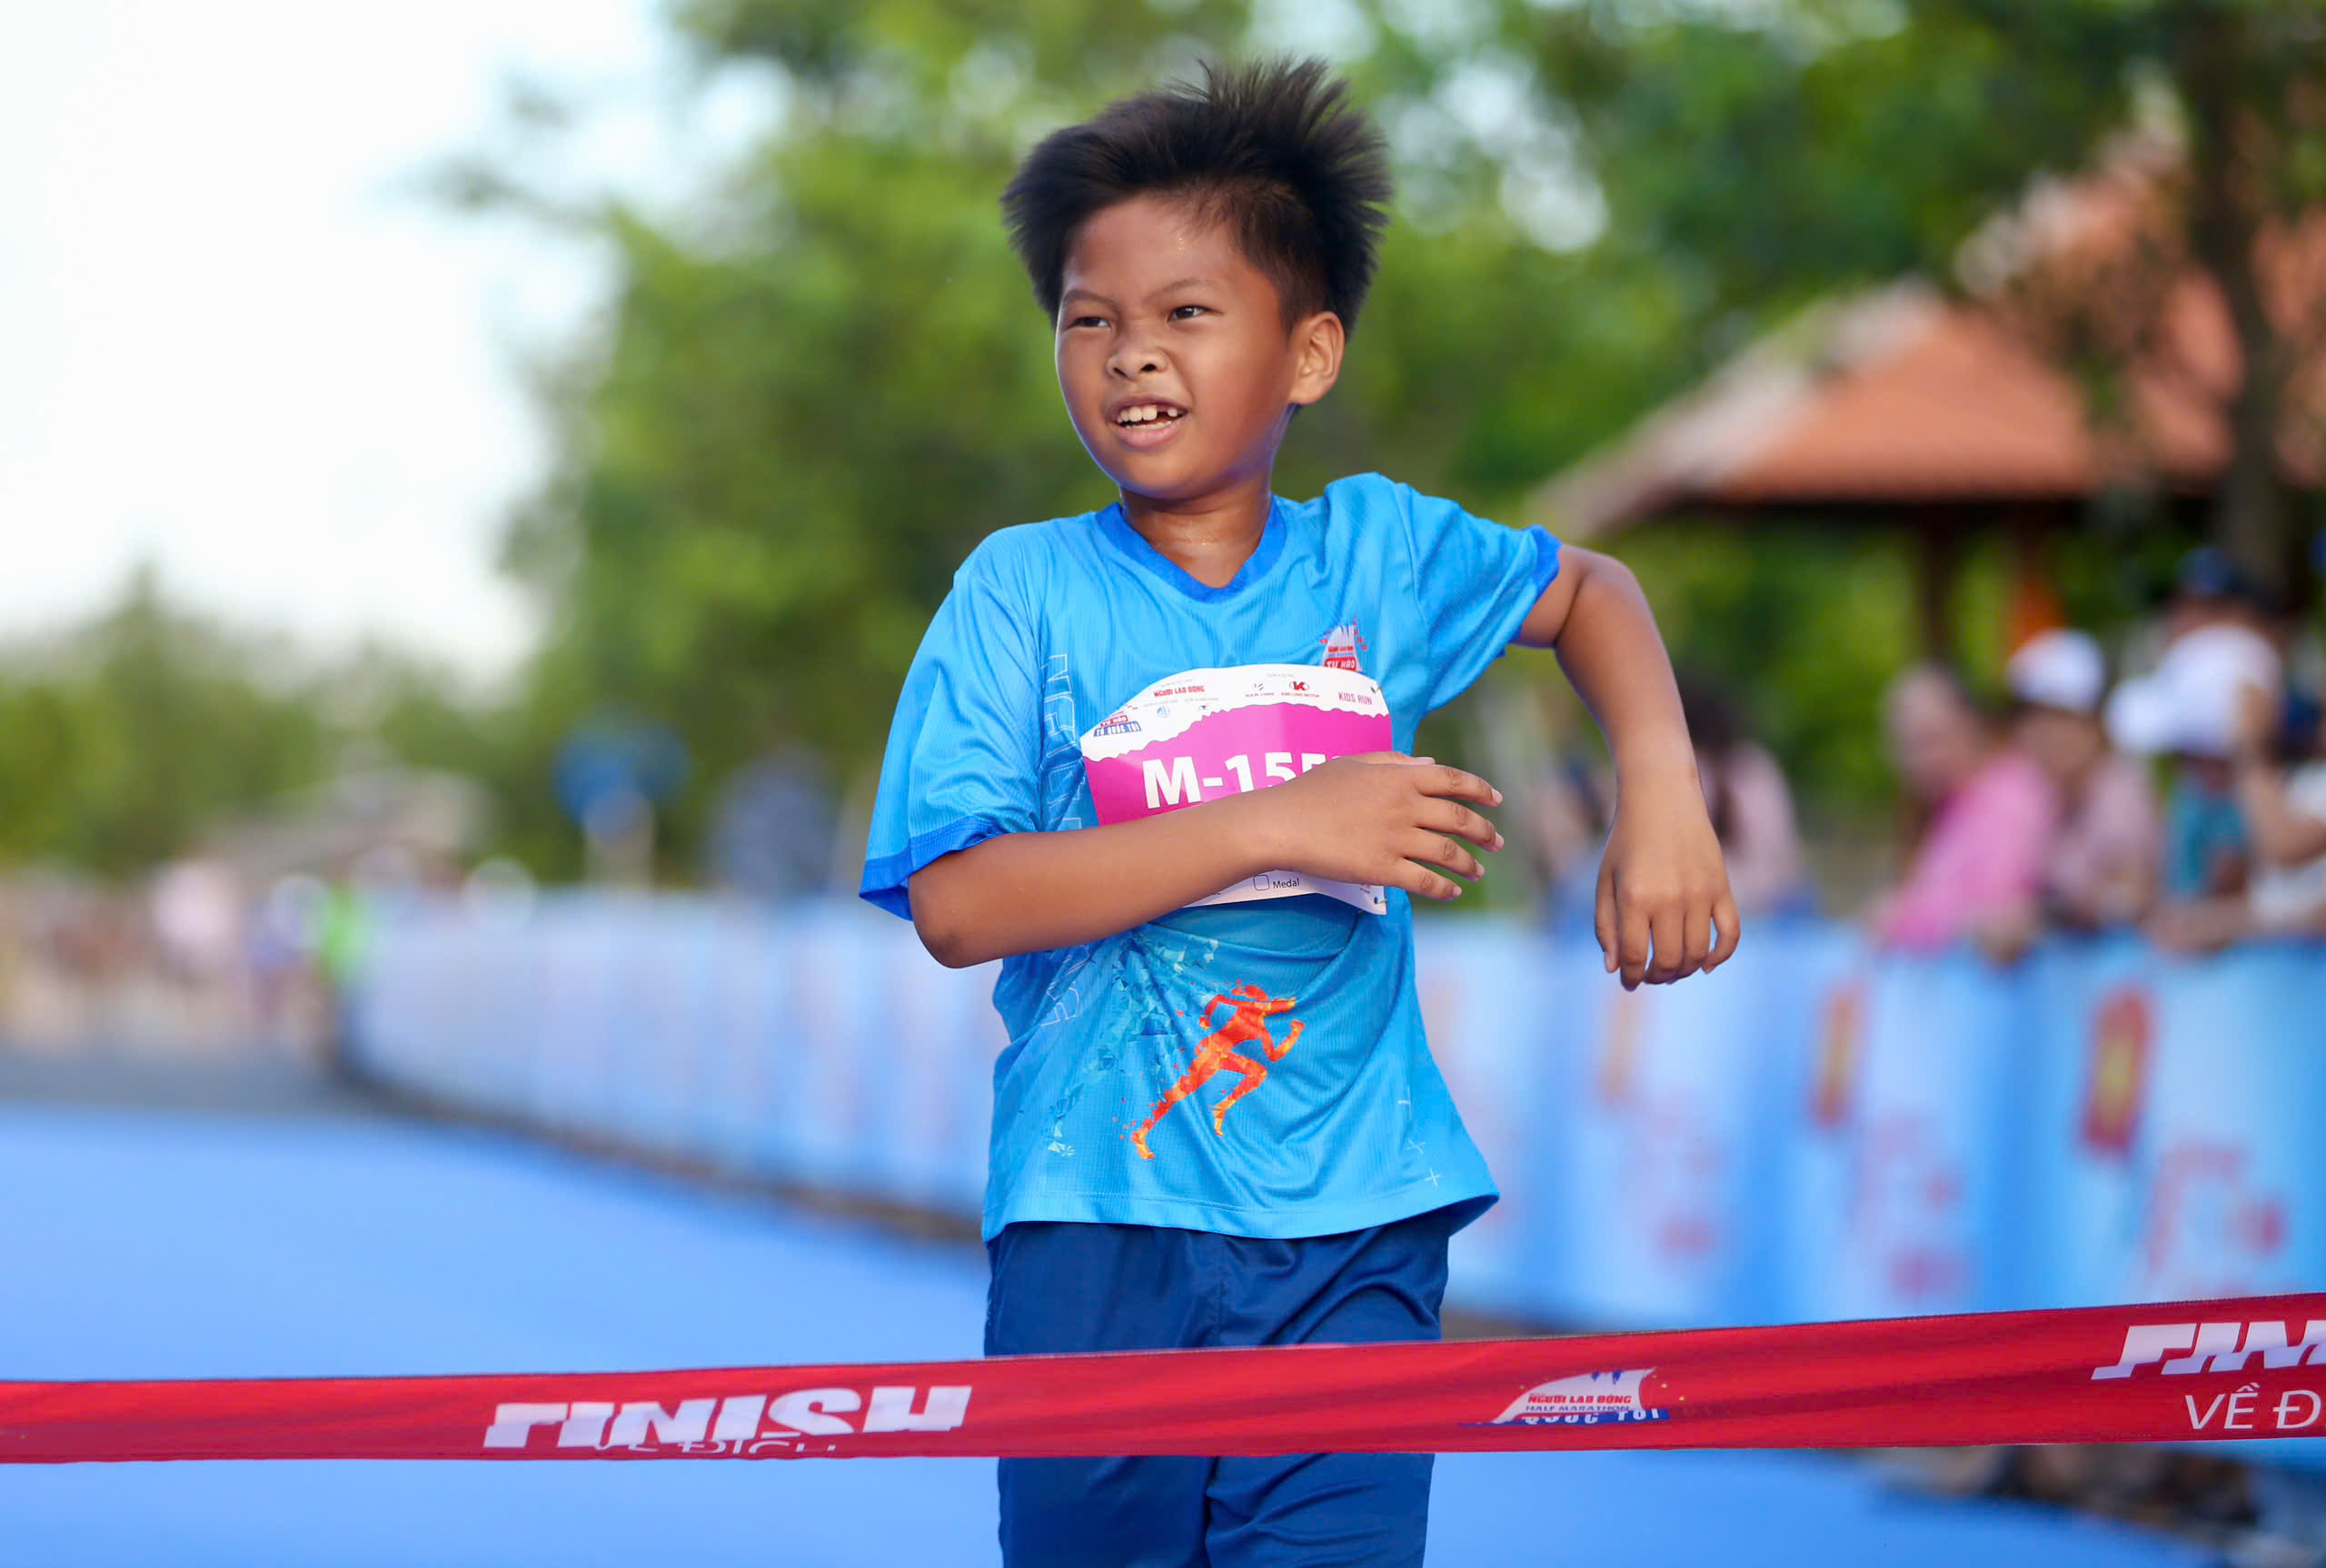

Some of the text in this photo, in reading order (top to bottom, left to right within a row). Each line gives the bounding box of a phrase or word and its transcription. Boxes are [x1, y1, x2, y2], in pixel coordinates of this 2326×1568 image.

[1338, 691, 1373, 706] KIDS RUN
[1273, 878, 1299, 889] Medal
[482, 1386, 974, 1448] FINISH
[2184, 1382, 2261, 1430] VỀ
